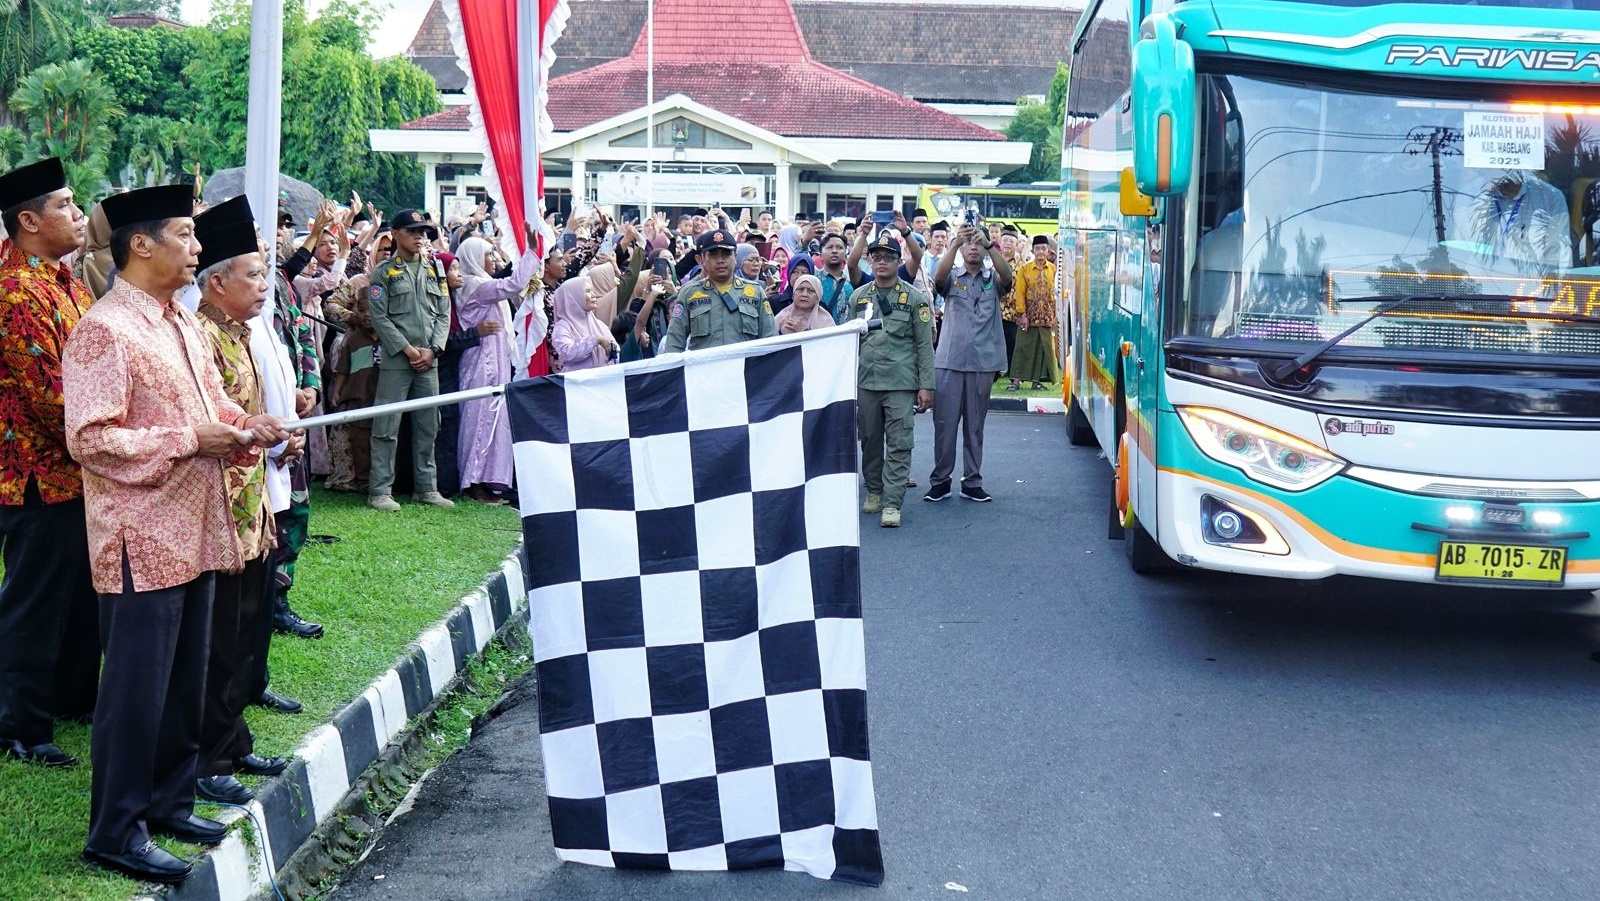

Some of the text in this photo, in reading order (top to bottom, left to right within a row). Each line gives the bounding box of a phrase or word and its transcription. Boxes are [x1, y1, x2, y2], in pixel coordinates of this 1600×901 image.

[1468, 125, 1542, 140] JAMAAH HAJI
[1489, 157, 1521, 166] 2025
[1443, 544, 1561, 570] AB 7015 ZR
